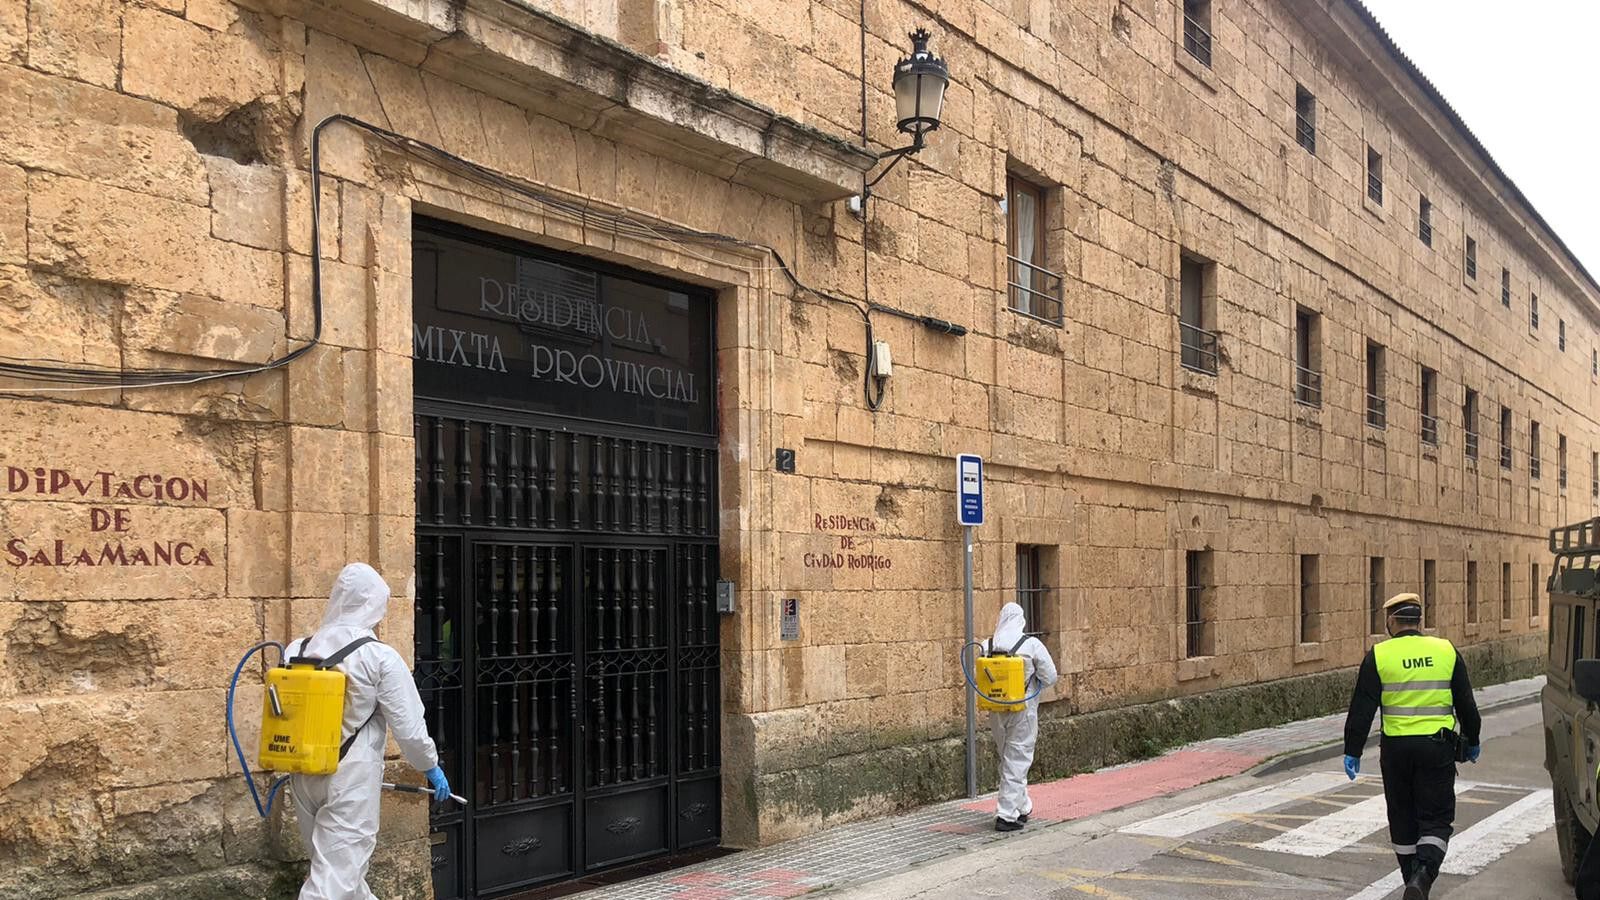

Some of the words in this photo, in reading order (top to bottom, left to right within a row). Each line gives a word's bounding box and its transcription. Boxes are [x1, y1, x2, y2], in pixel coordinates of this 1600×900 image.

[479, 277, 651, 345] RESIDENCIA
[412, 323, 508, 373] MIXTA
[531, 343, 699, 404] PROVINCIAL
[782, 450, 792, 470] 2
[90, 508, 130, 532] DE
[840, 535, 855, 550] DE
[1402, 656, 1434, 669] UME
[268, 743, 287, 752] BIEM
[274, 735, 290, 743] UME
